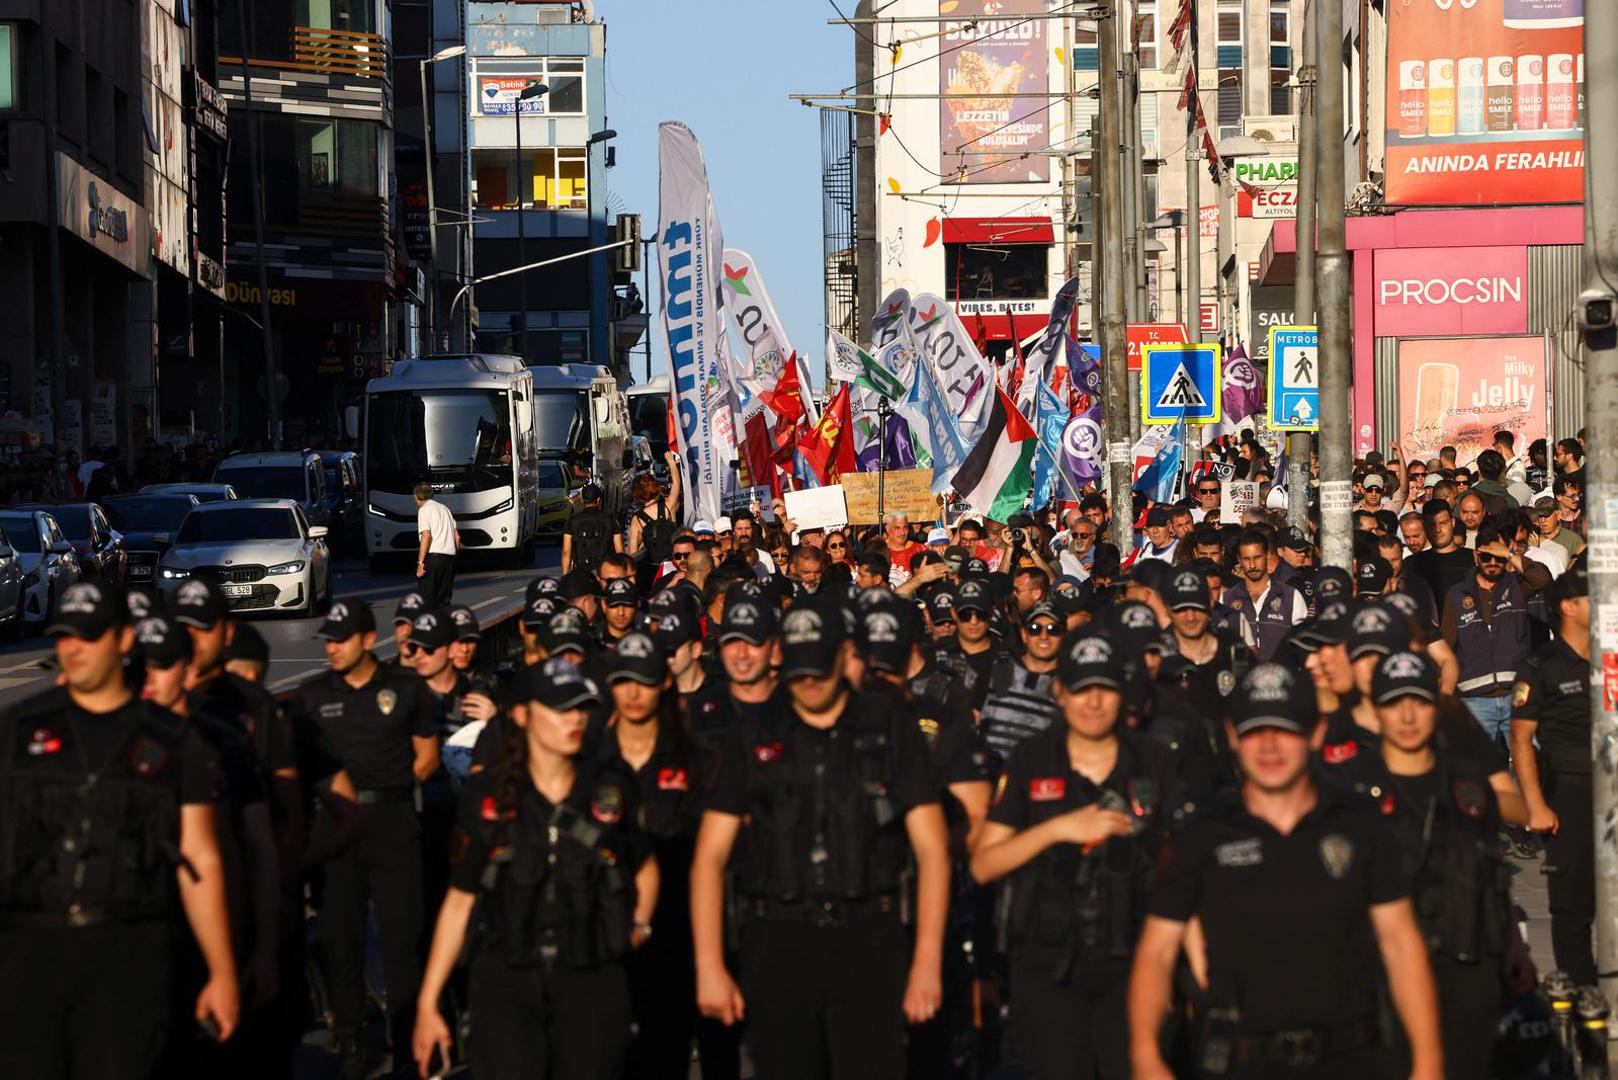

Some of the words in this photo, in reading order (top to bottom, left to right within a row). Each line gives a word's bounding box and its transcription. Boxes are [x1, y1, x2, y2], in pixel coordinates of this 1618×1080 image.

[1488, 104, 1513, 113] SMILE
[1405, 154, 1489, 173] ANINDA
[225, 281, 297, 306] Dünası
[1381, 277, 1521, 304] PROCSIN
[960, 303, 996, 312] VIBES,
[1504, 361, 1535, 377] Milky
[1472, 377, 1535, 413] Jelly
[1212, 464, 1232, 476] NO
